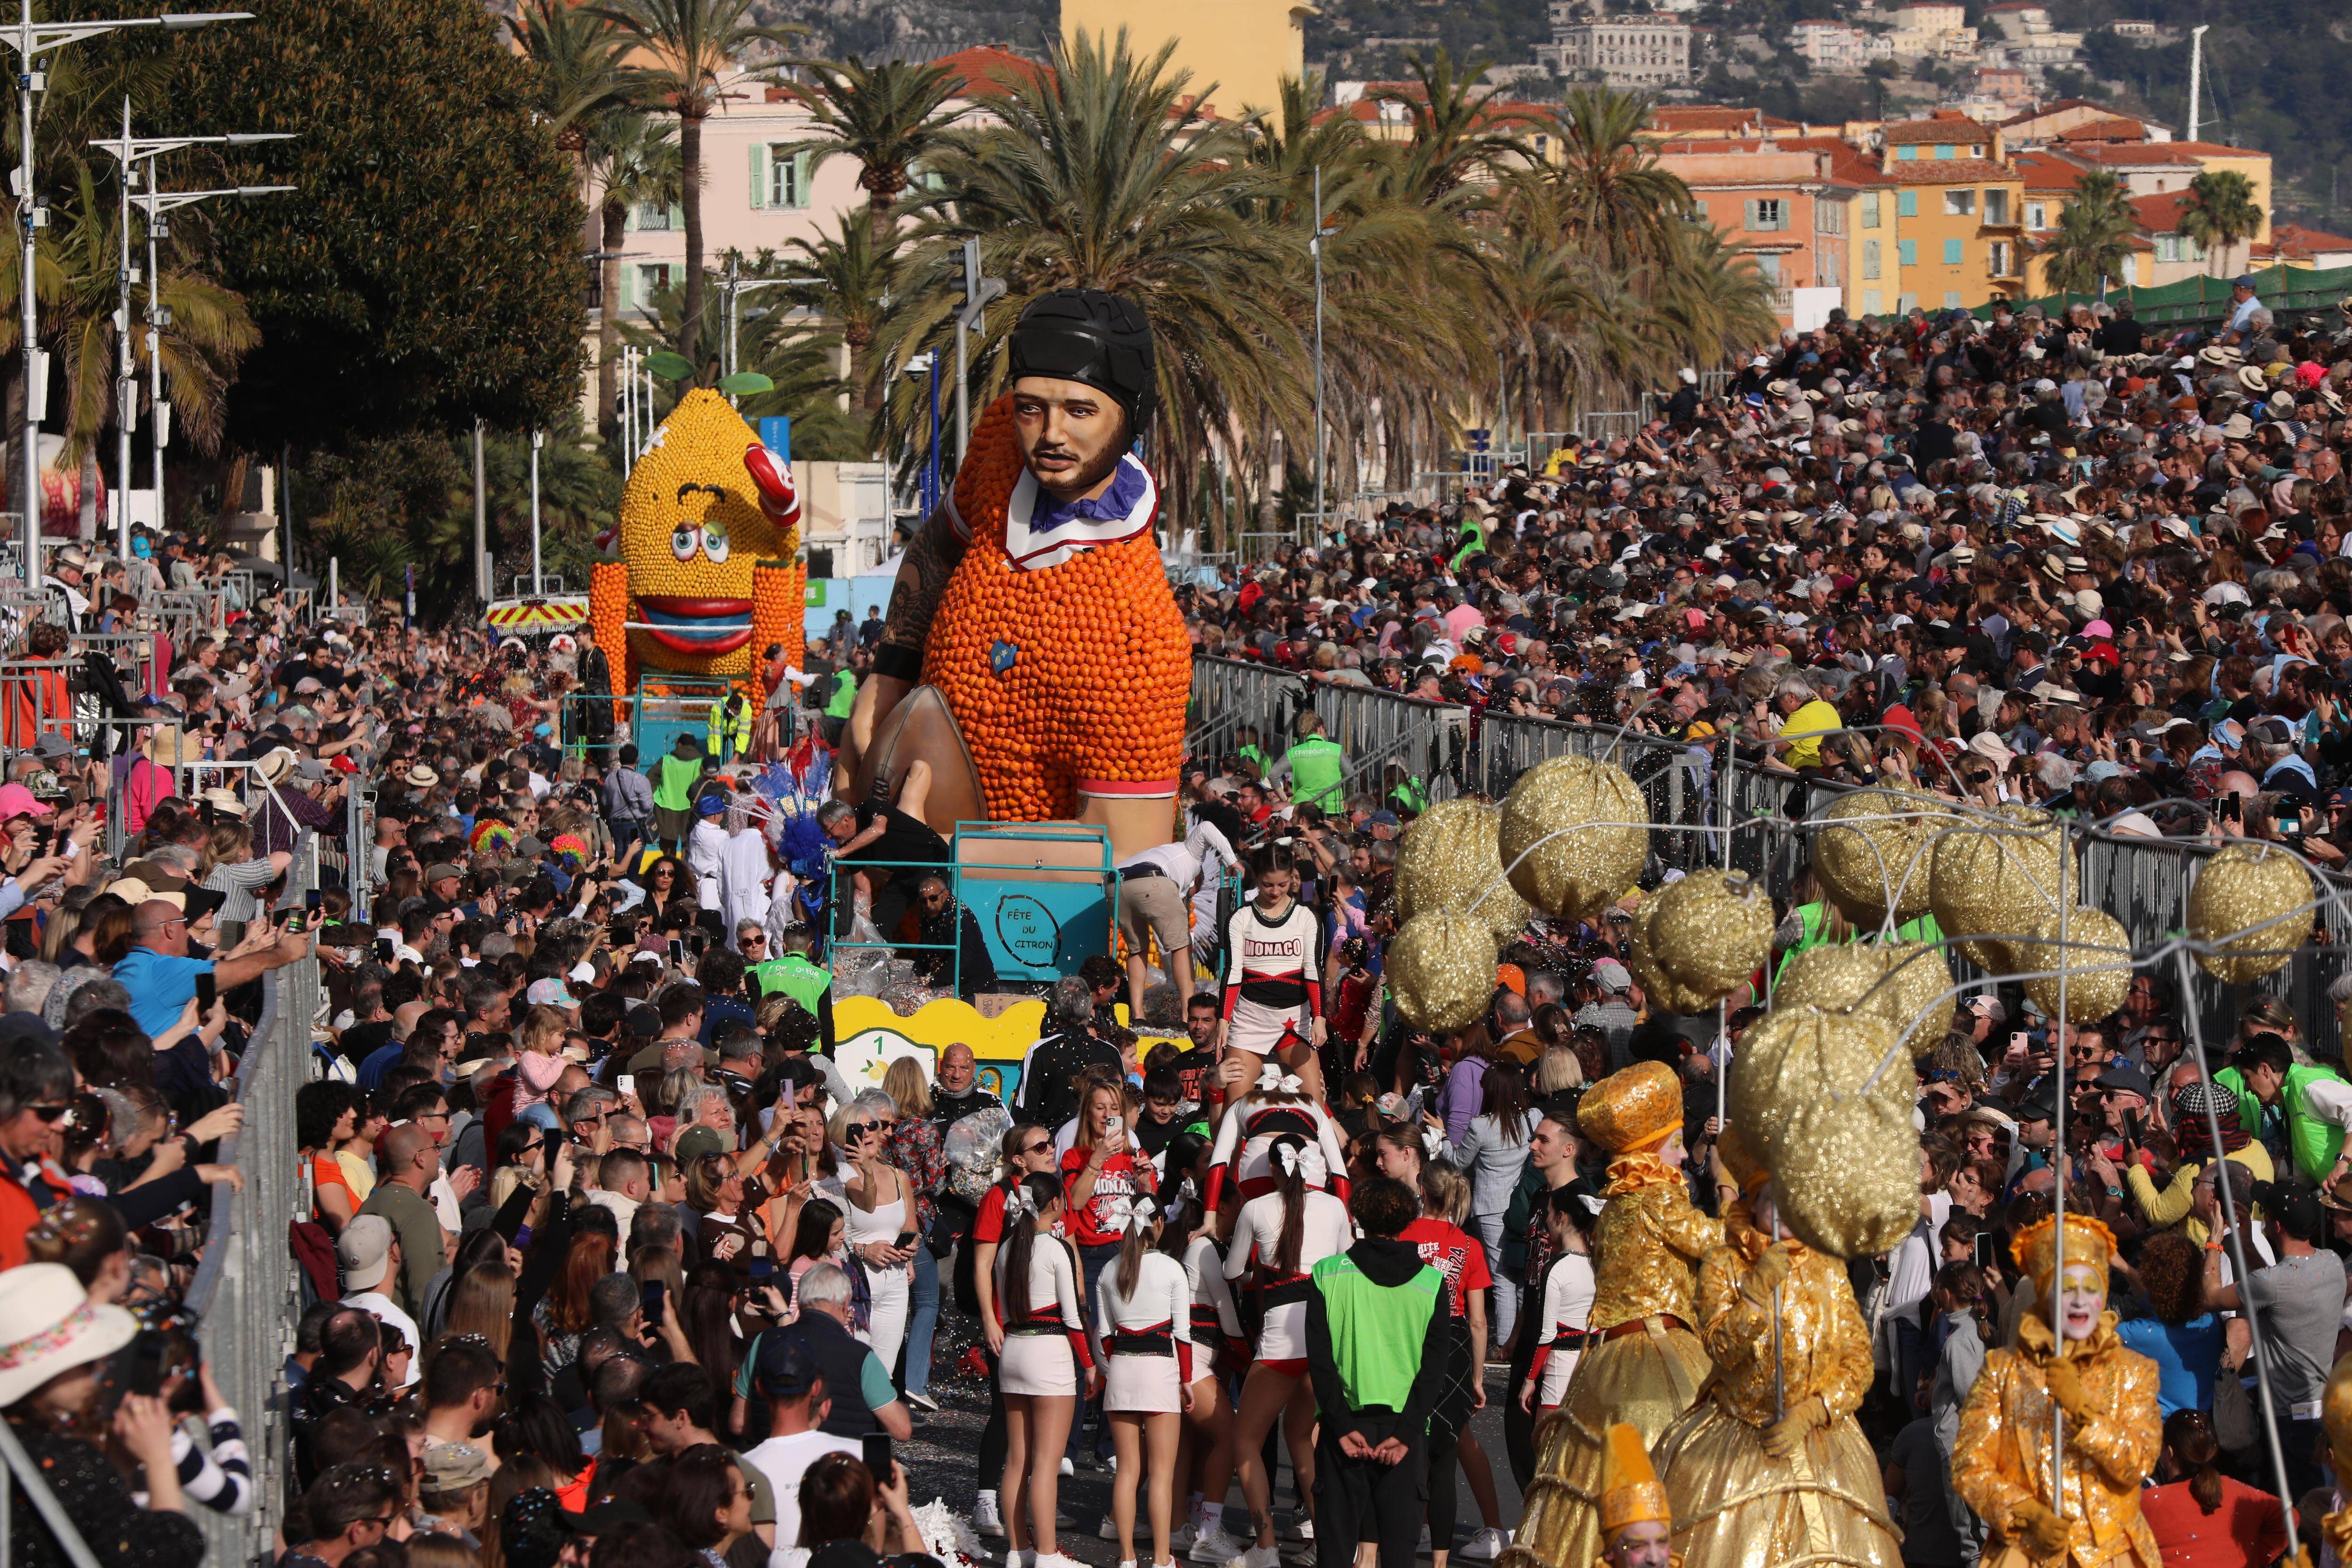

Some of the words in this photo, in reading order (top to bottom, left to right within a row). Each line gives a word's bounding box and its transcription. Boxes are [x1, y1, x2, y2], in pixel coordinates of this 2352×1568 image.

[542, 623, 578, 633] FRANÇAIS
[1008, 908, 1032, 920] FÊTE
[1014, 940, 1053, 949] CITRON
[1244, 938, 1302, 957] MONACO
[982, 999, 993, 1019] HARMES
[874, 1036, 883, 1055] 1
[1271, 1073, 1290, 1085] MONACO
[1091, 1178, 1138, 1196] MONAC
[1121, 1208, 1142, 1218] MONACO
[1418, 1242, 1439, 1253] HITE
[1432, 1256, 1453, 1271] RED
